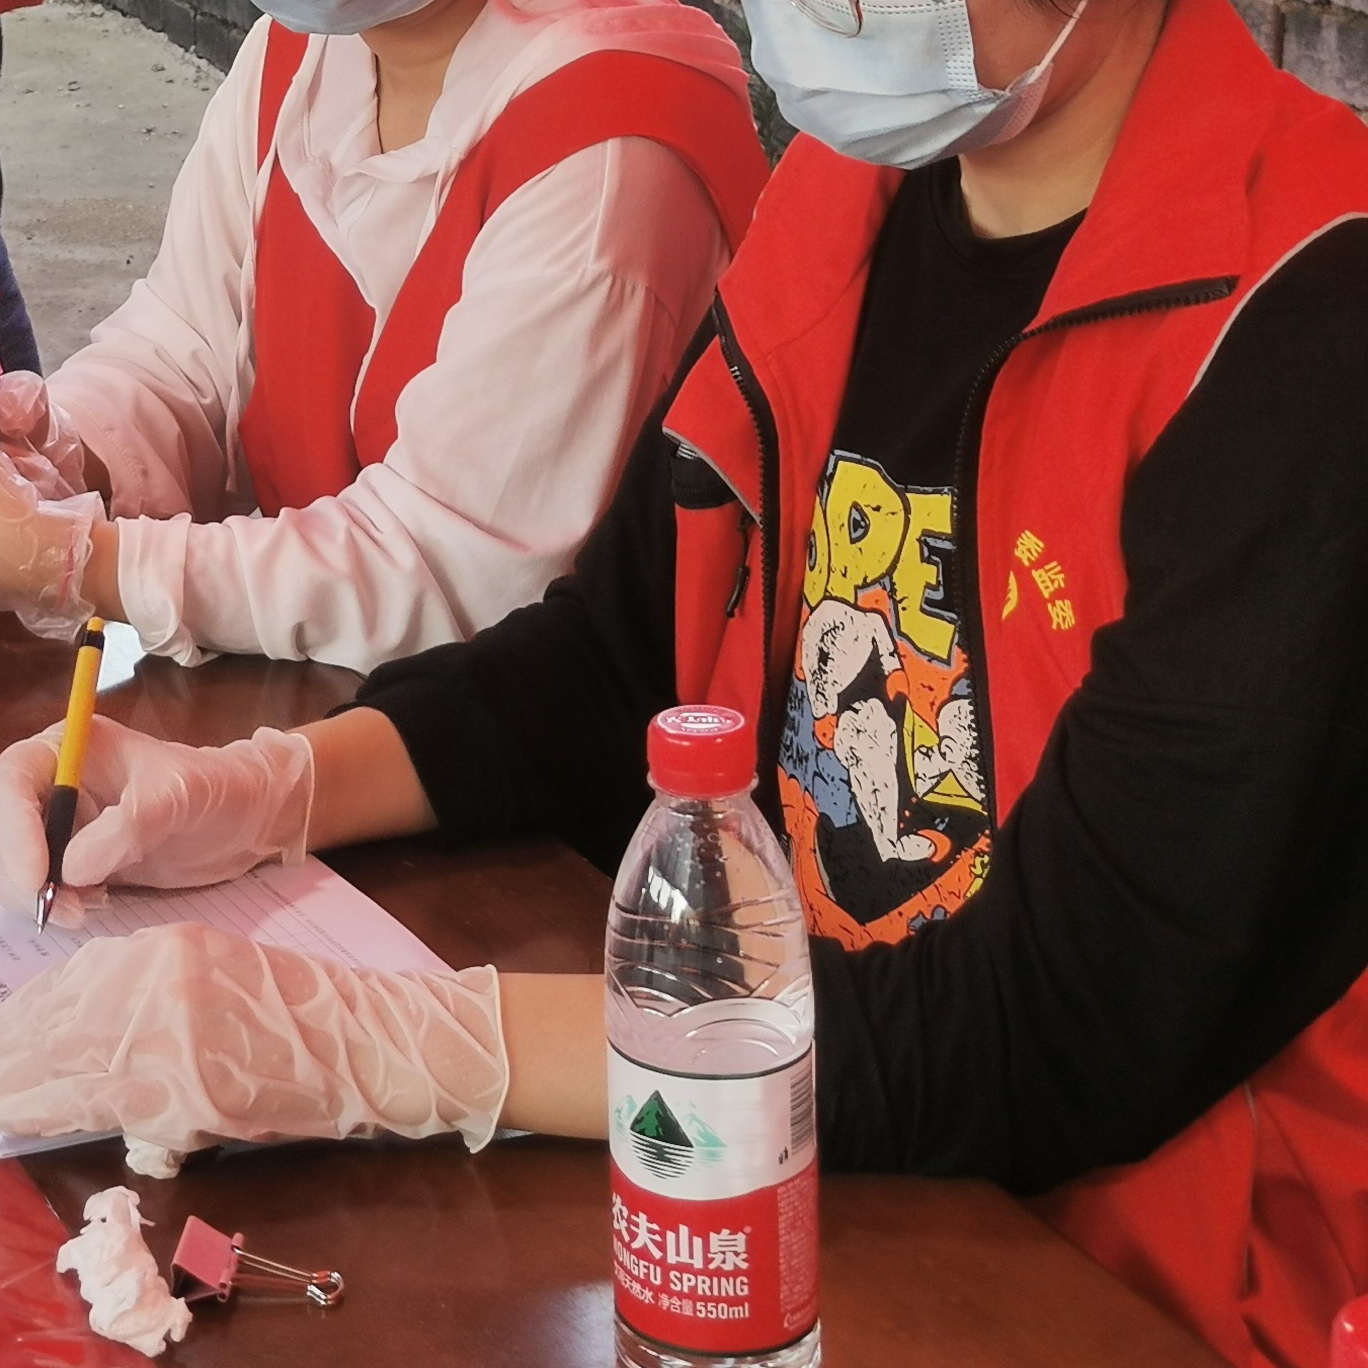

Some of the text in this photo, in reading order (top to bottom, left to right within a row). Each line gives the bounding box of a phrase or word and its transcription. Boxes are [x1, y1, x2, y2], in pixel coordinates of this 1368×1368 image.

[611, 1190, 750, 1271] 农夫山泉
[668, 1270, 750, 1297] SPRING
